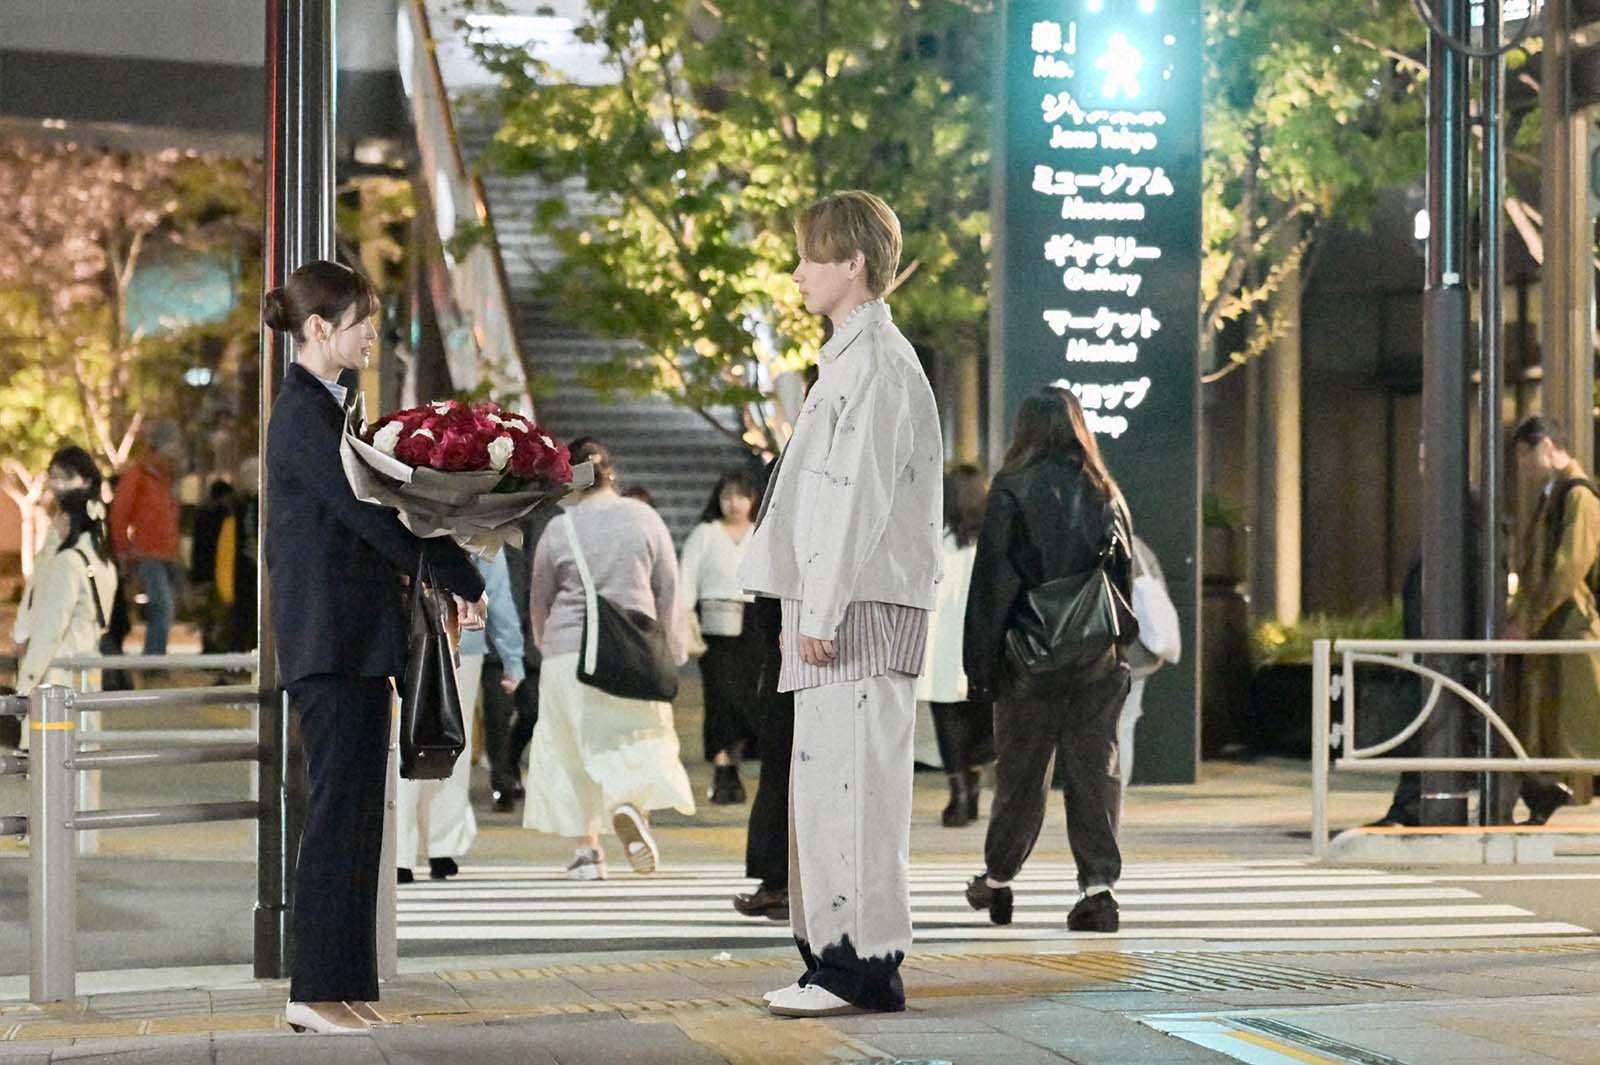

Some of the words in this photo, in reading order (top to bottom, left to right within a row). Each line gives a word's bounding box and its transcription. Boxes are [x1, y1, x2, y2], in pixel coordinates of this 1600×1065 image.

[1031, 163, 1174, 196] ミュージアム
[1061, 196, 1145, 221] Museum
[1044, 233, 1162, 267] ギャラリー
[1063, 266, 1142, 297] Gallery
[1042, 306, 1161, 339] マーケット
[1065, 338, 1139, 362] Market
[1083, 409, 1128, 439] hop
